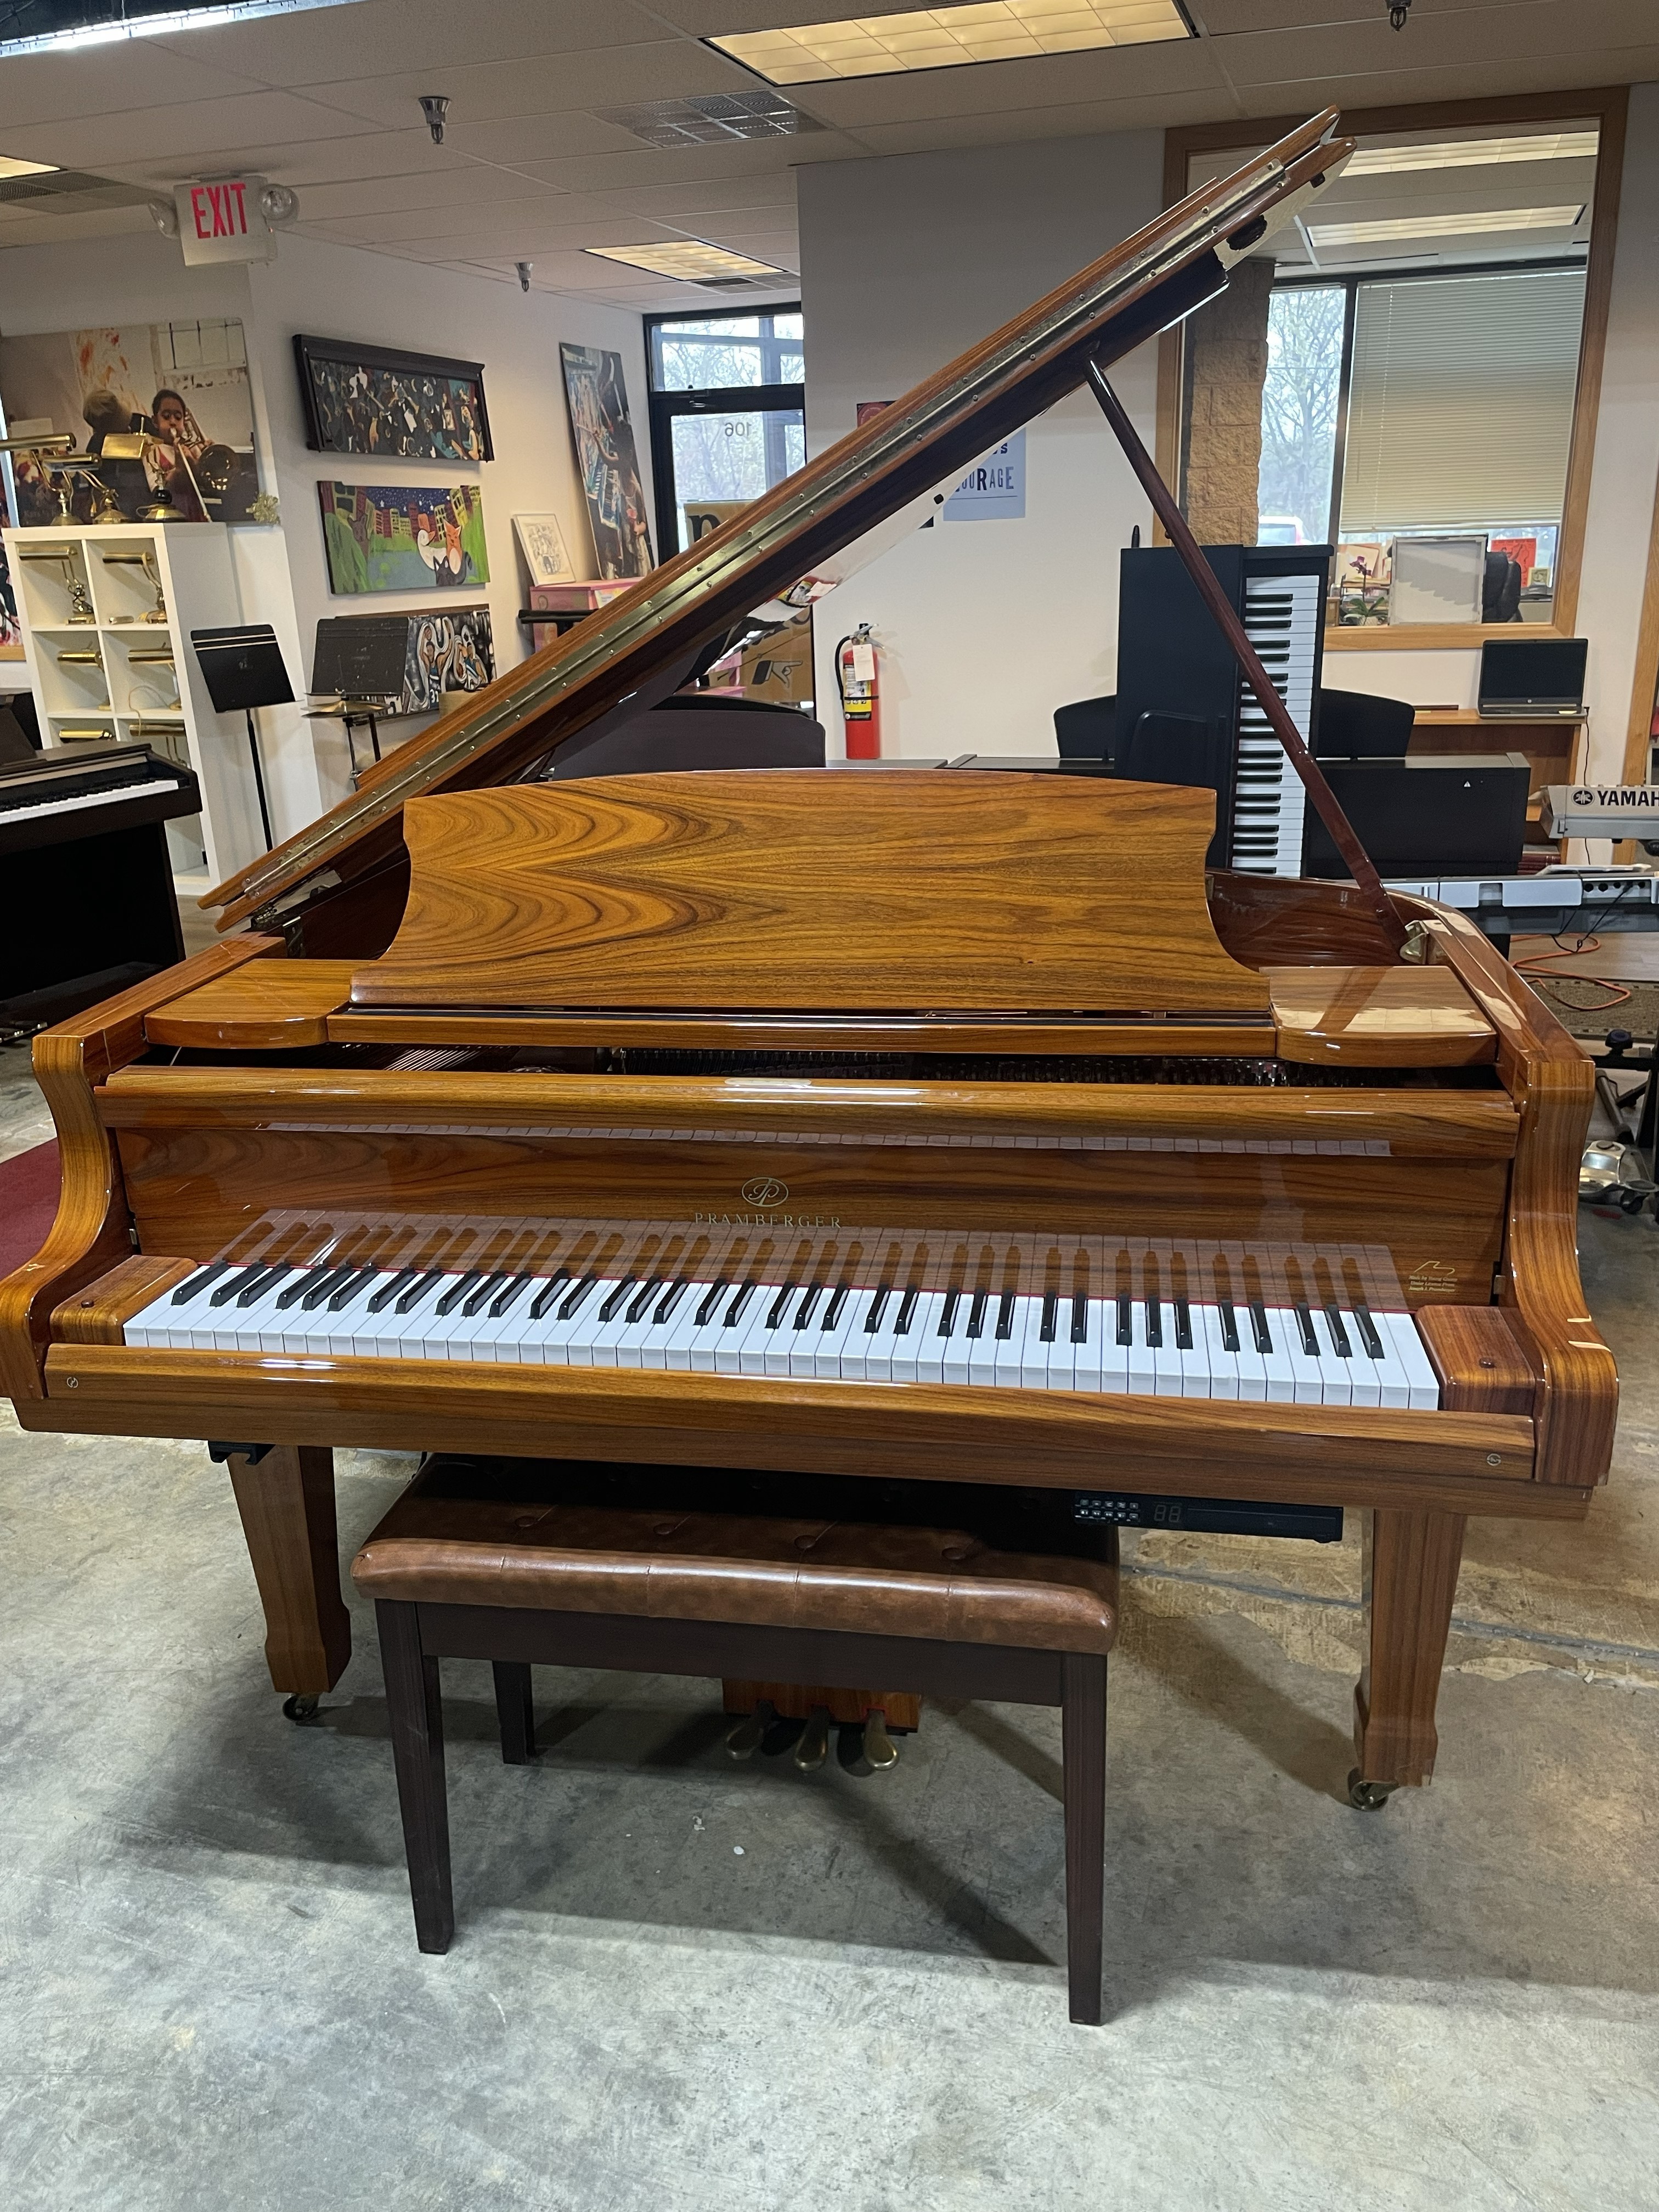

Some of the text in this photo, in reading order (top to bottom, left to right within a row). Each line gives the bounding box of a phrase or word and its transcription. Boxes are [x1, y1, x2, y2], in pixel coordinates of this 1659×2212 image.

[191, 184, 247, 239] EXIT
[955, 466, 1014, 492] URAGE
[695, 1212, 842, 1229] PRAMBERGER
